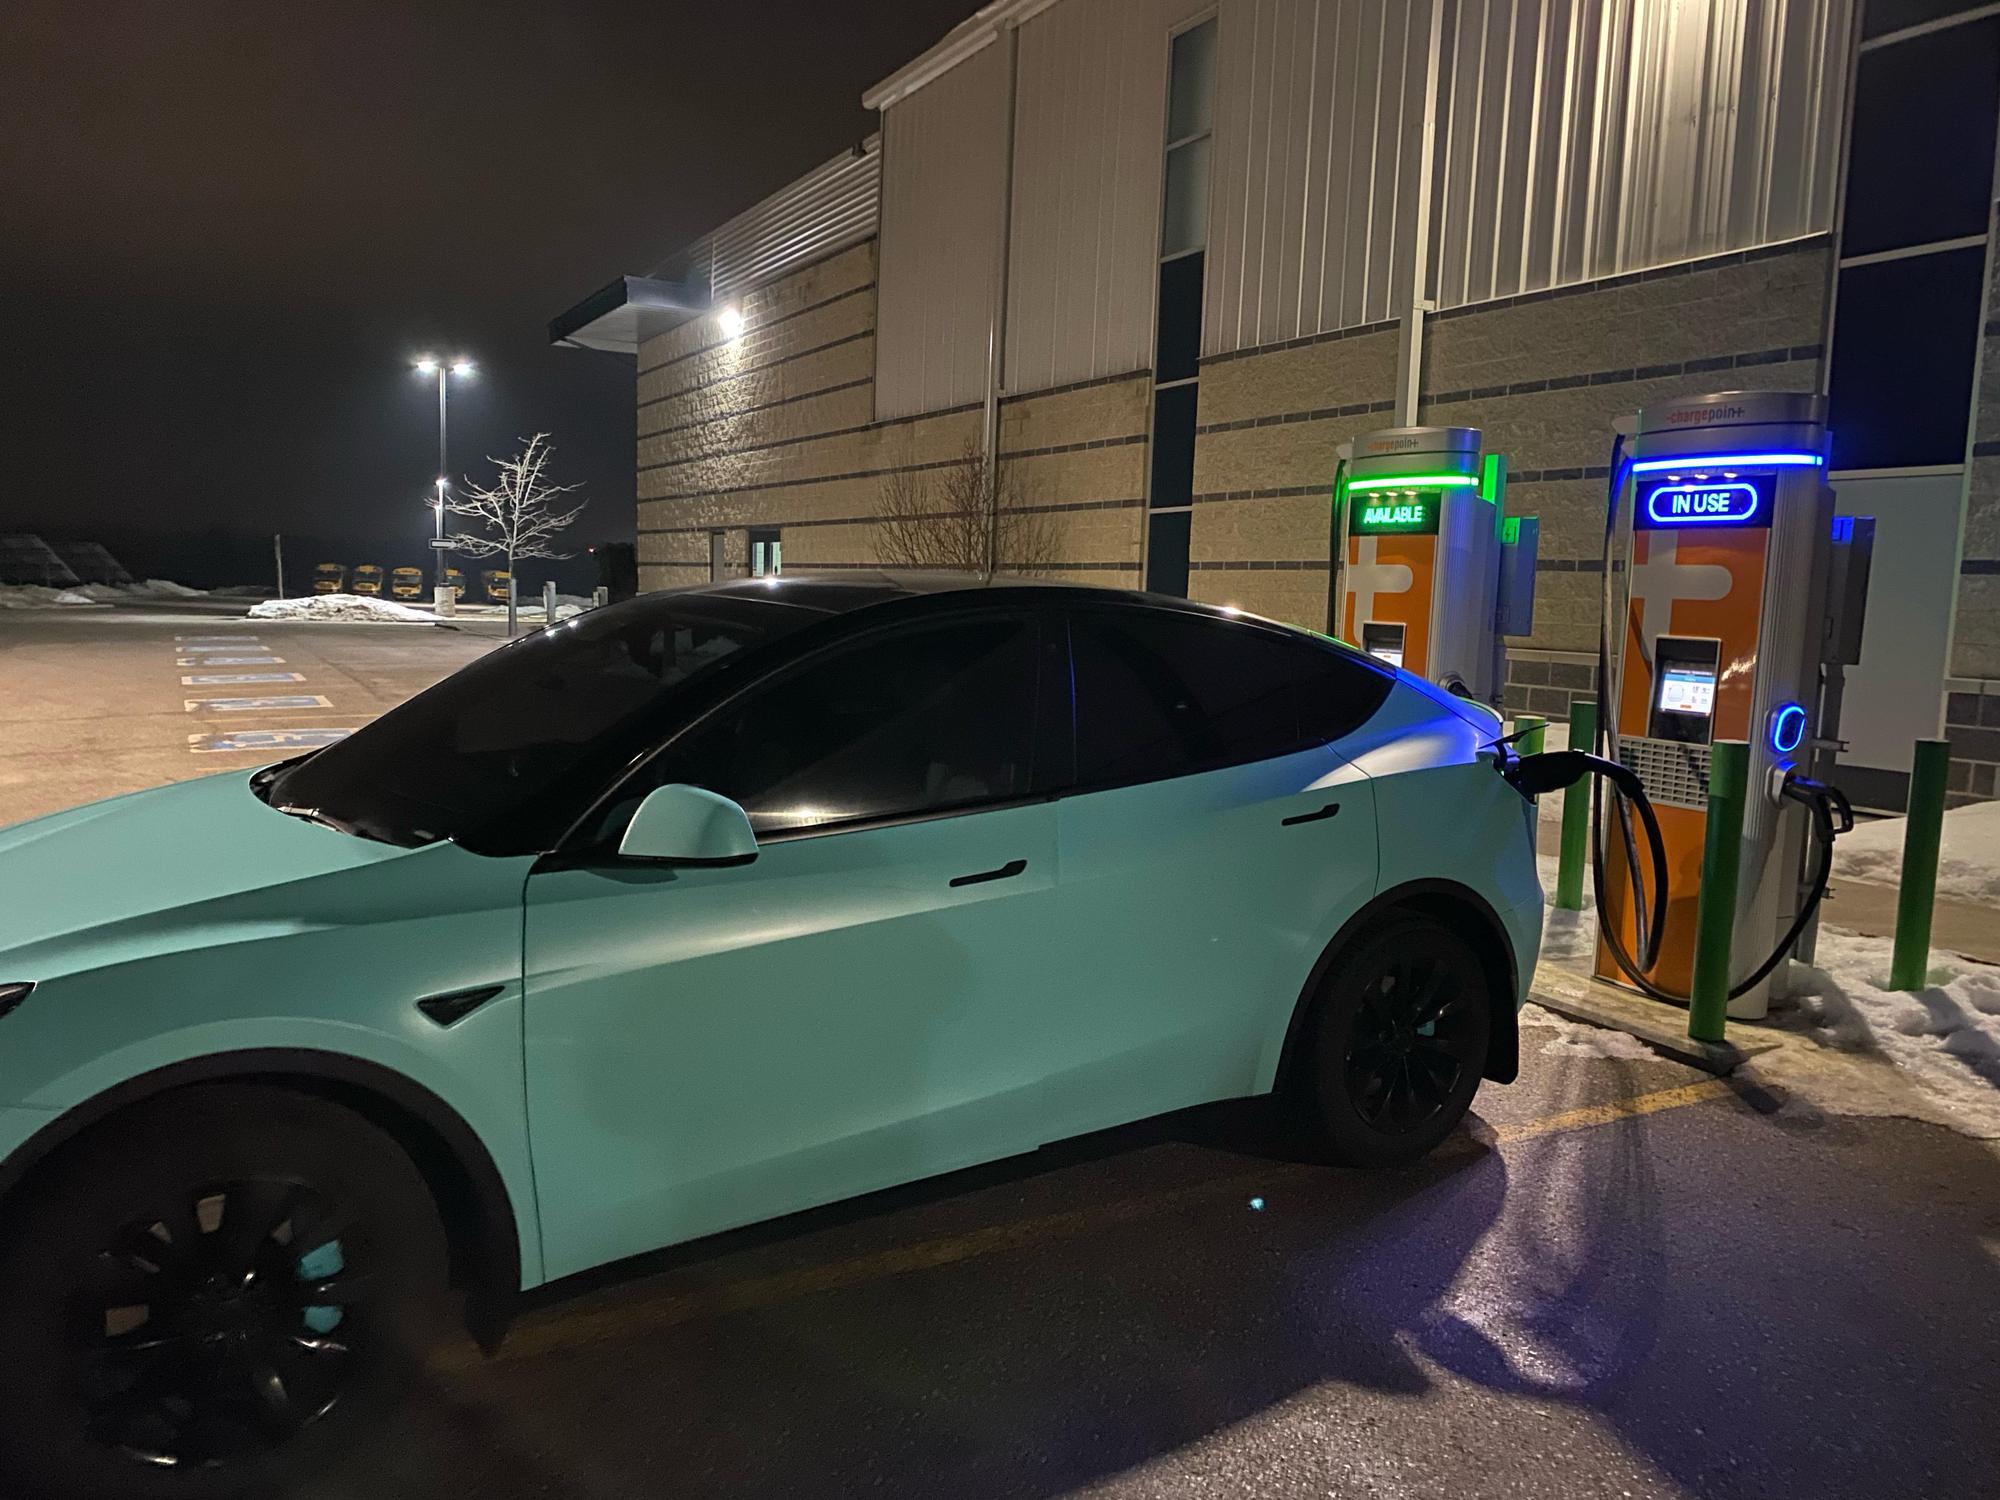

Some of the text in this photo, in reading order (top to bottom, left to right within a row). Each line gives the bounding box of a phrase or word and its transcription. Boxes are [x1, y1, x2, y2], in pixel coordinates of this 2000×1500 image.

[1672, 492, 1731, 513] IN USE
[1363, 506, 1423, 524] AVAILABLE
